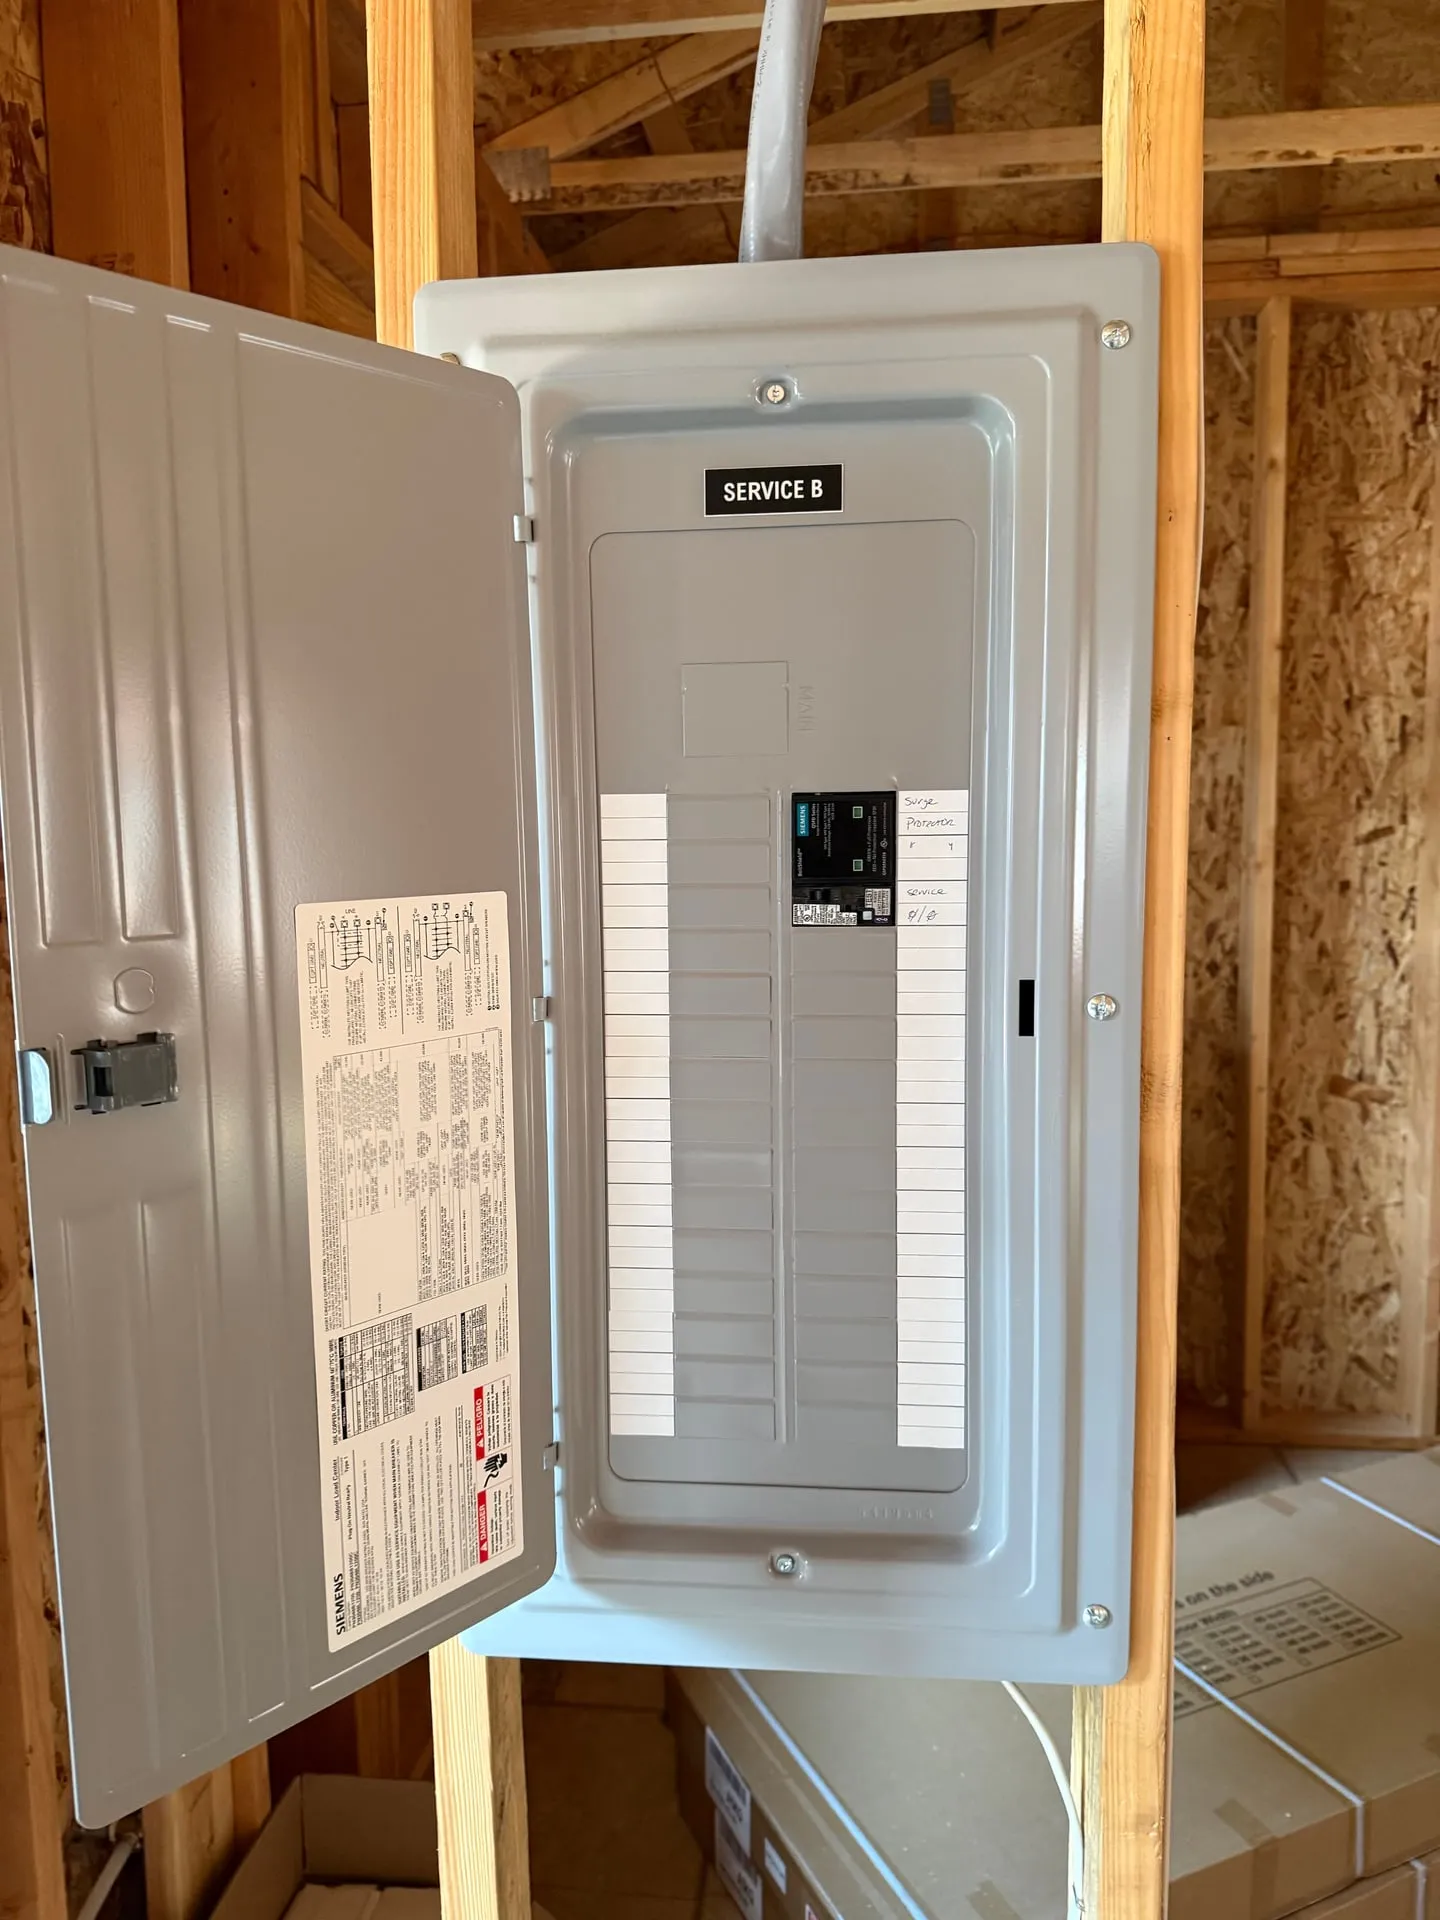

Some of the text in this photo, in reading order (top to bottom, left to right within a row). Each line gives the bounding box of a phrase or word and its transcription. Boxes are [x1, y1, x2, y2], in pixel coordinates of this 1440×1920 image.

[723, 479, 824, 502] SERVICE B
[333, 1573, 345, 1635] SIEMENS
[1185, 1592, 1209, 1605] on
[1208, 1581, 1238, 1597] the
[1239, 1570, 1274, 1588] side
